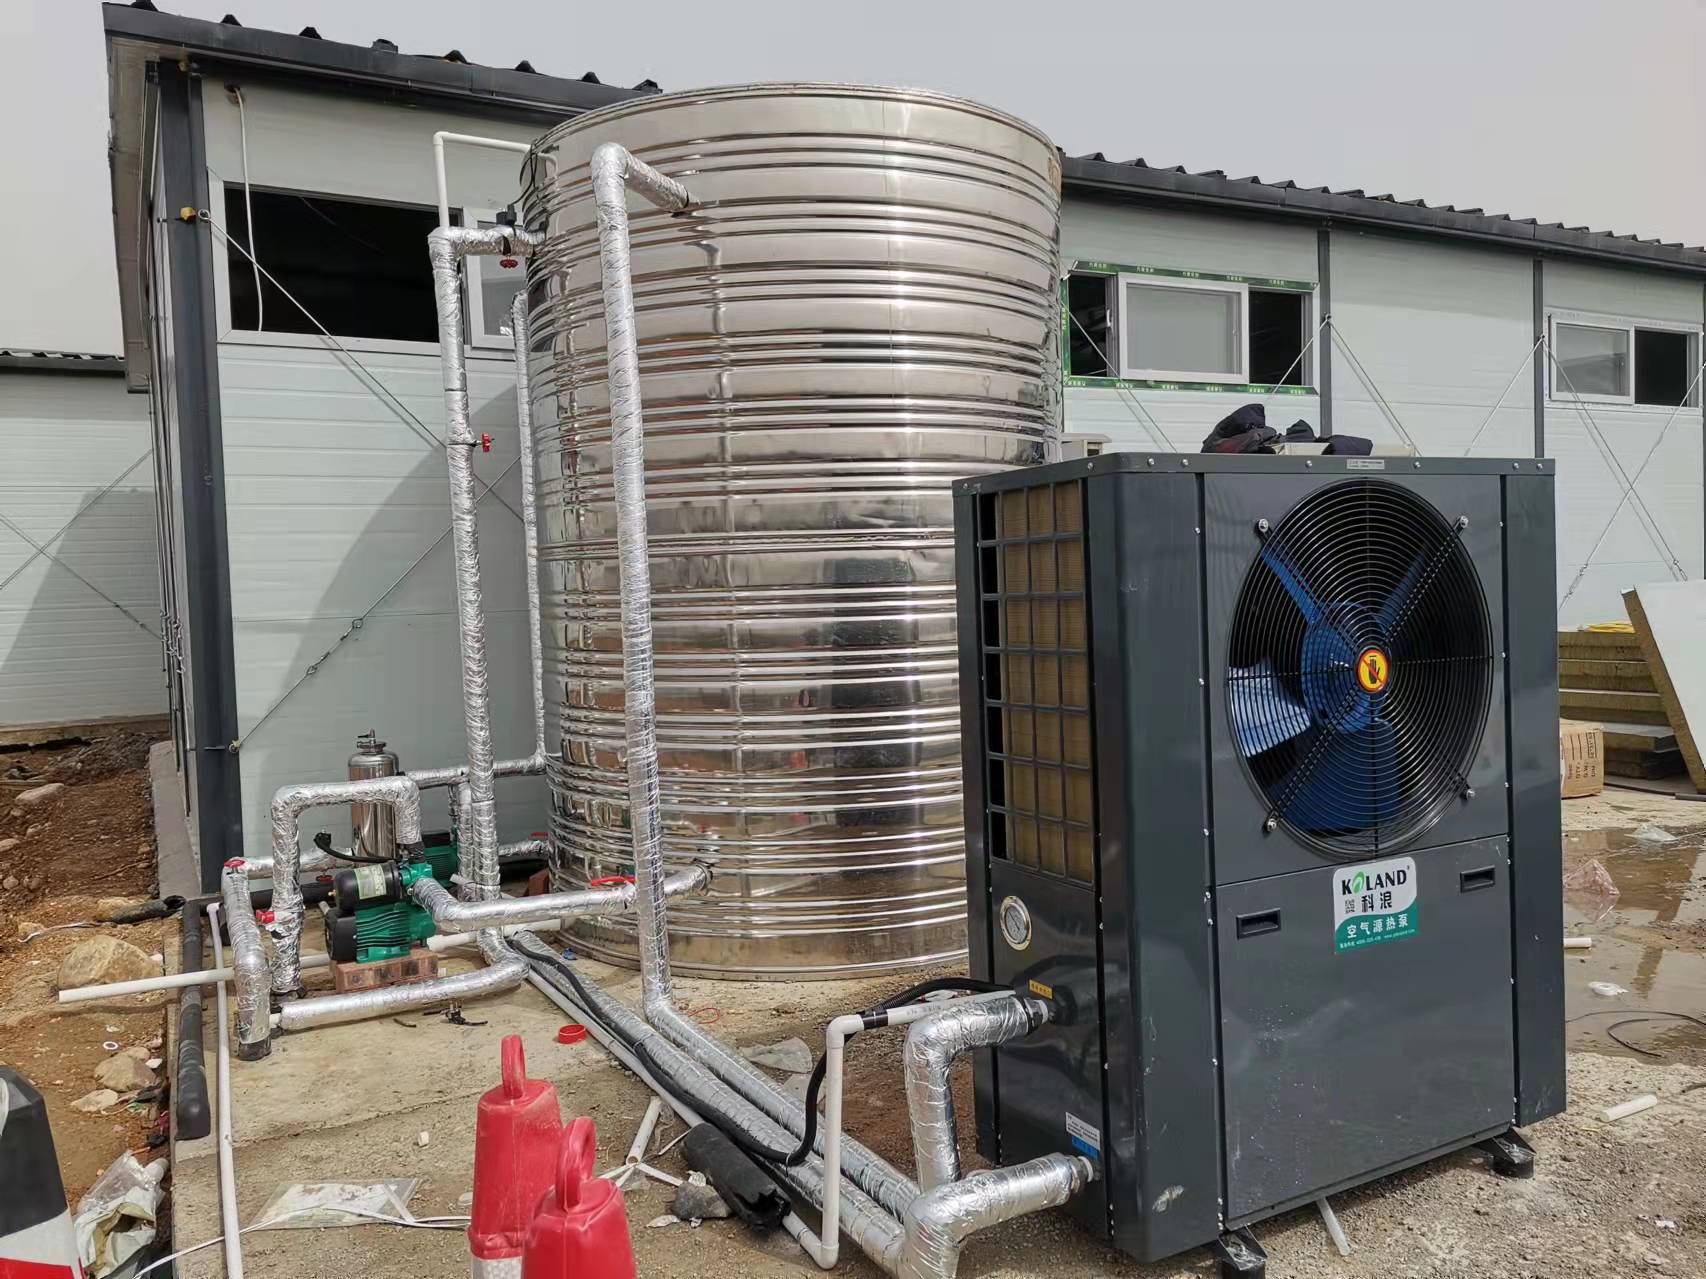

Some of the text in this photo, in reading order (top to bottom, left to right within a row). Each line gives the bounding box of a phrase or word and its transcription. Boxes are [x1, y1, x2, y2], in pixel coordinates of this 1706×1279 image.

[1361, 891, 1392, 913] 科浪
[1346, 914, 1408, 938] 空气源热泵
